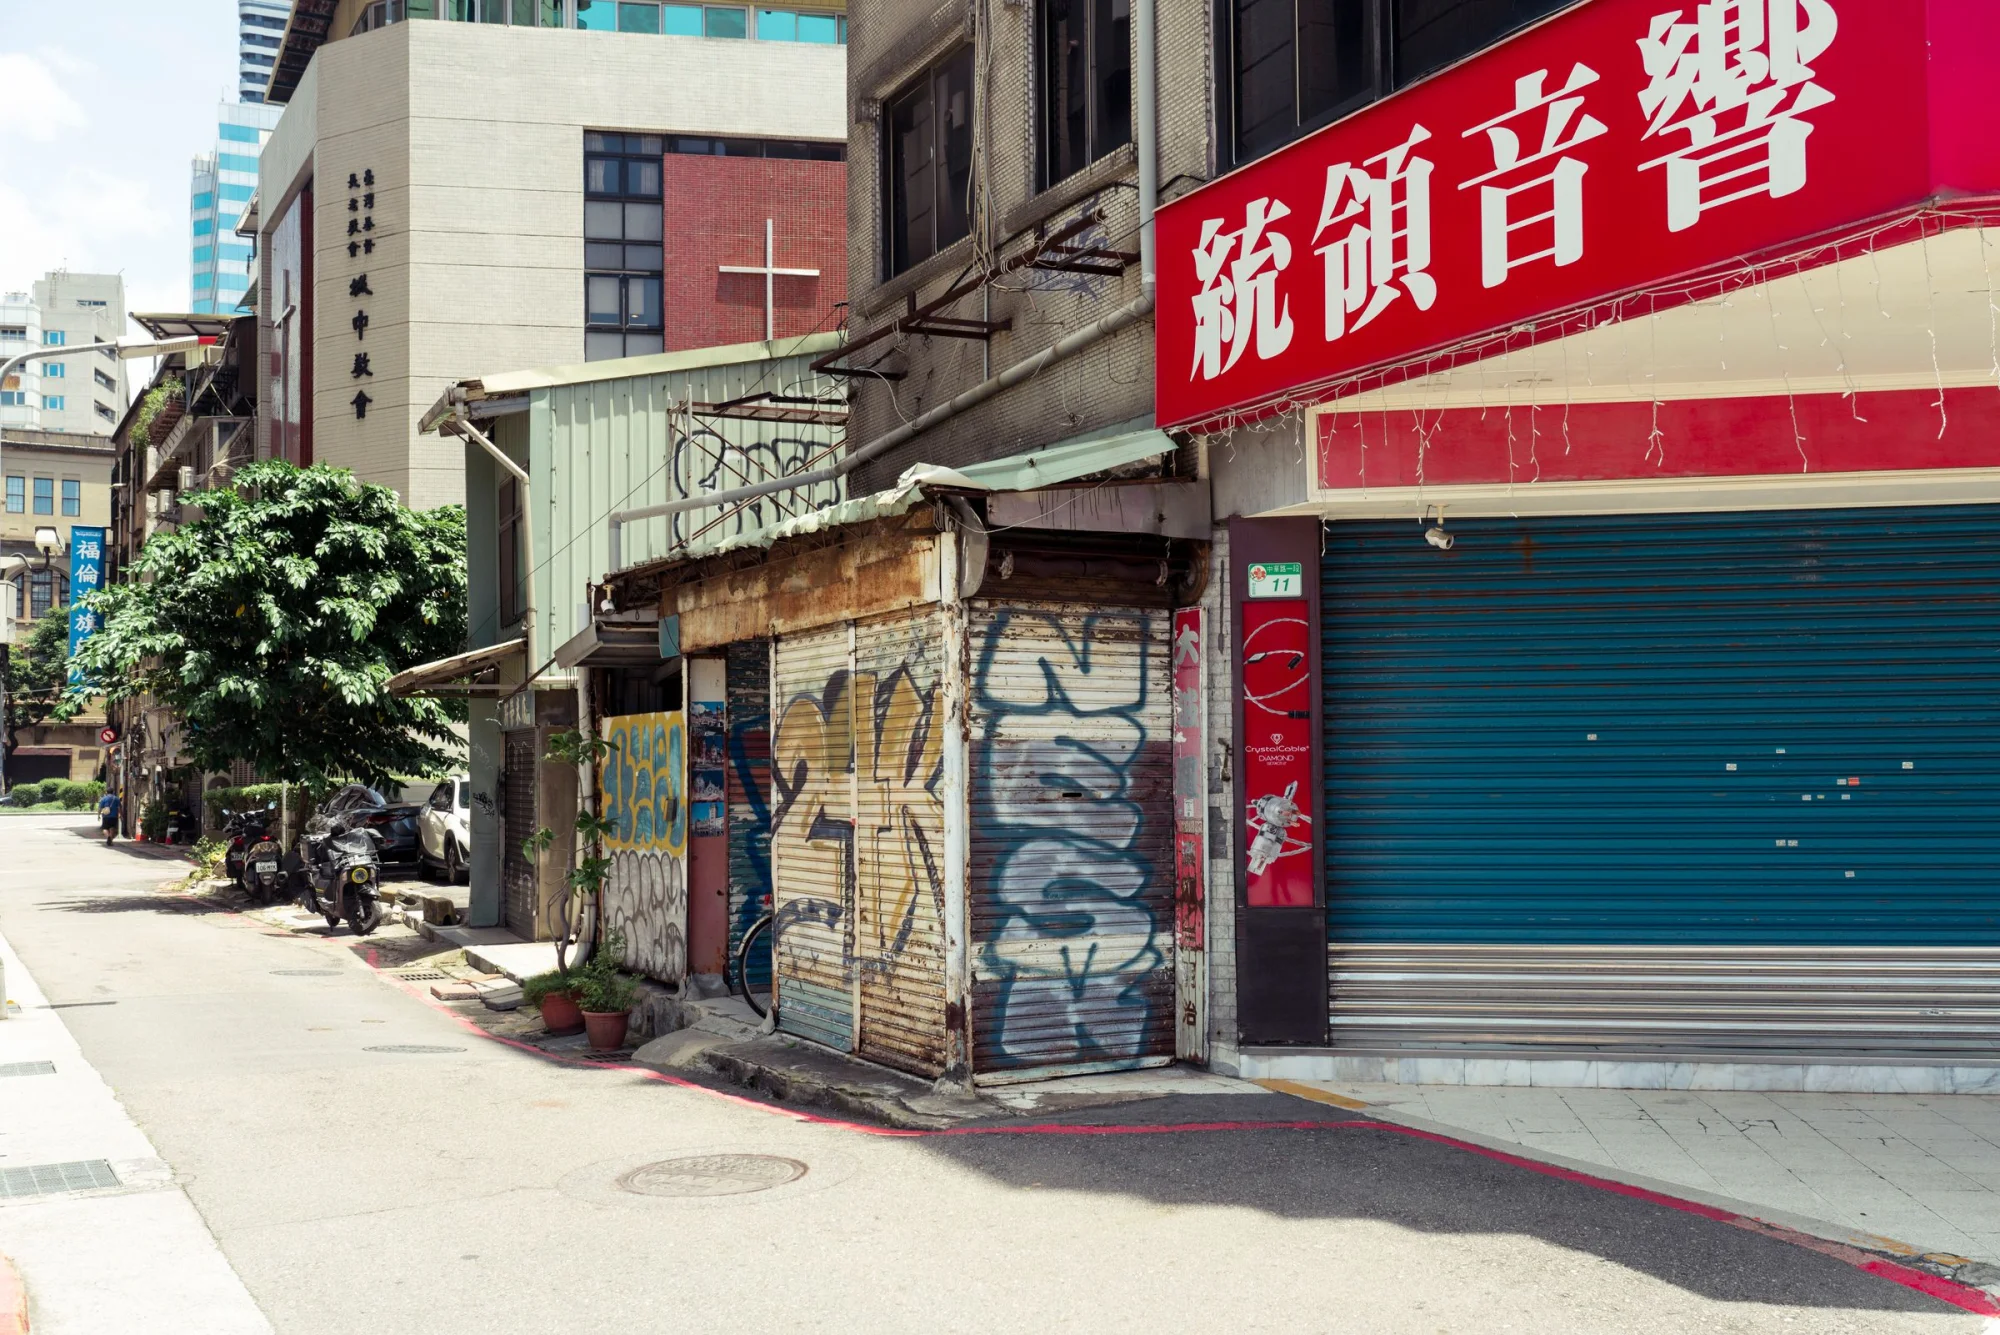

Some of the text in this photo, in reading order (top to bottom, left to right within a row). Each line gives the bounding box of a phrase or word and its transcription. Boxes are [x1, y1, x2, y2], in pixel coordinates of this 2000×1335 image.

[1190, 0, 1838, 381] 統領音響
[1272, 577, 1290, 592] 11
